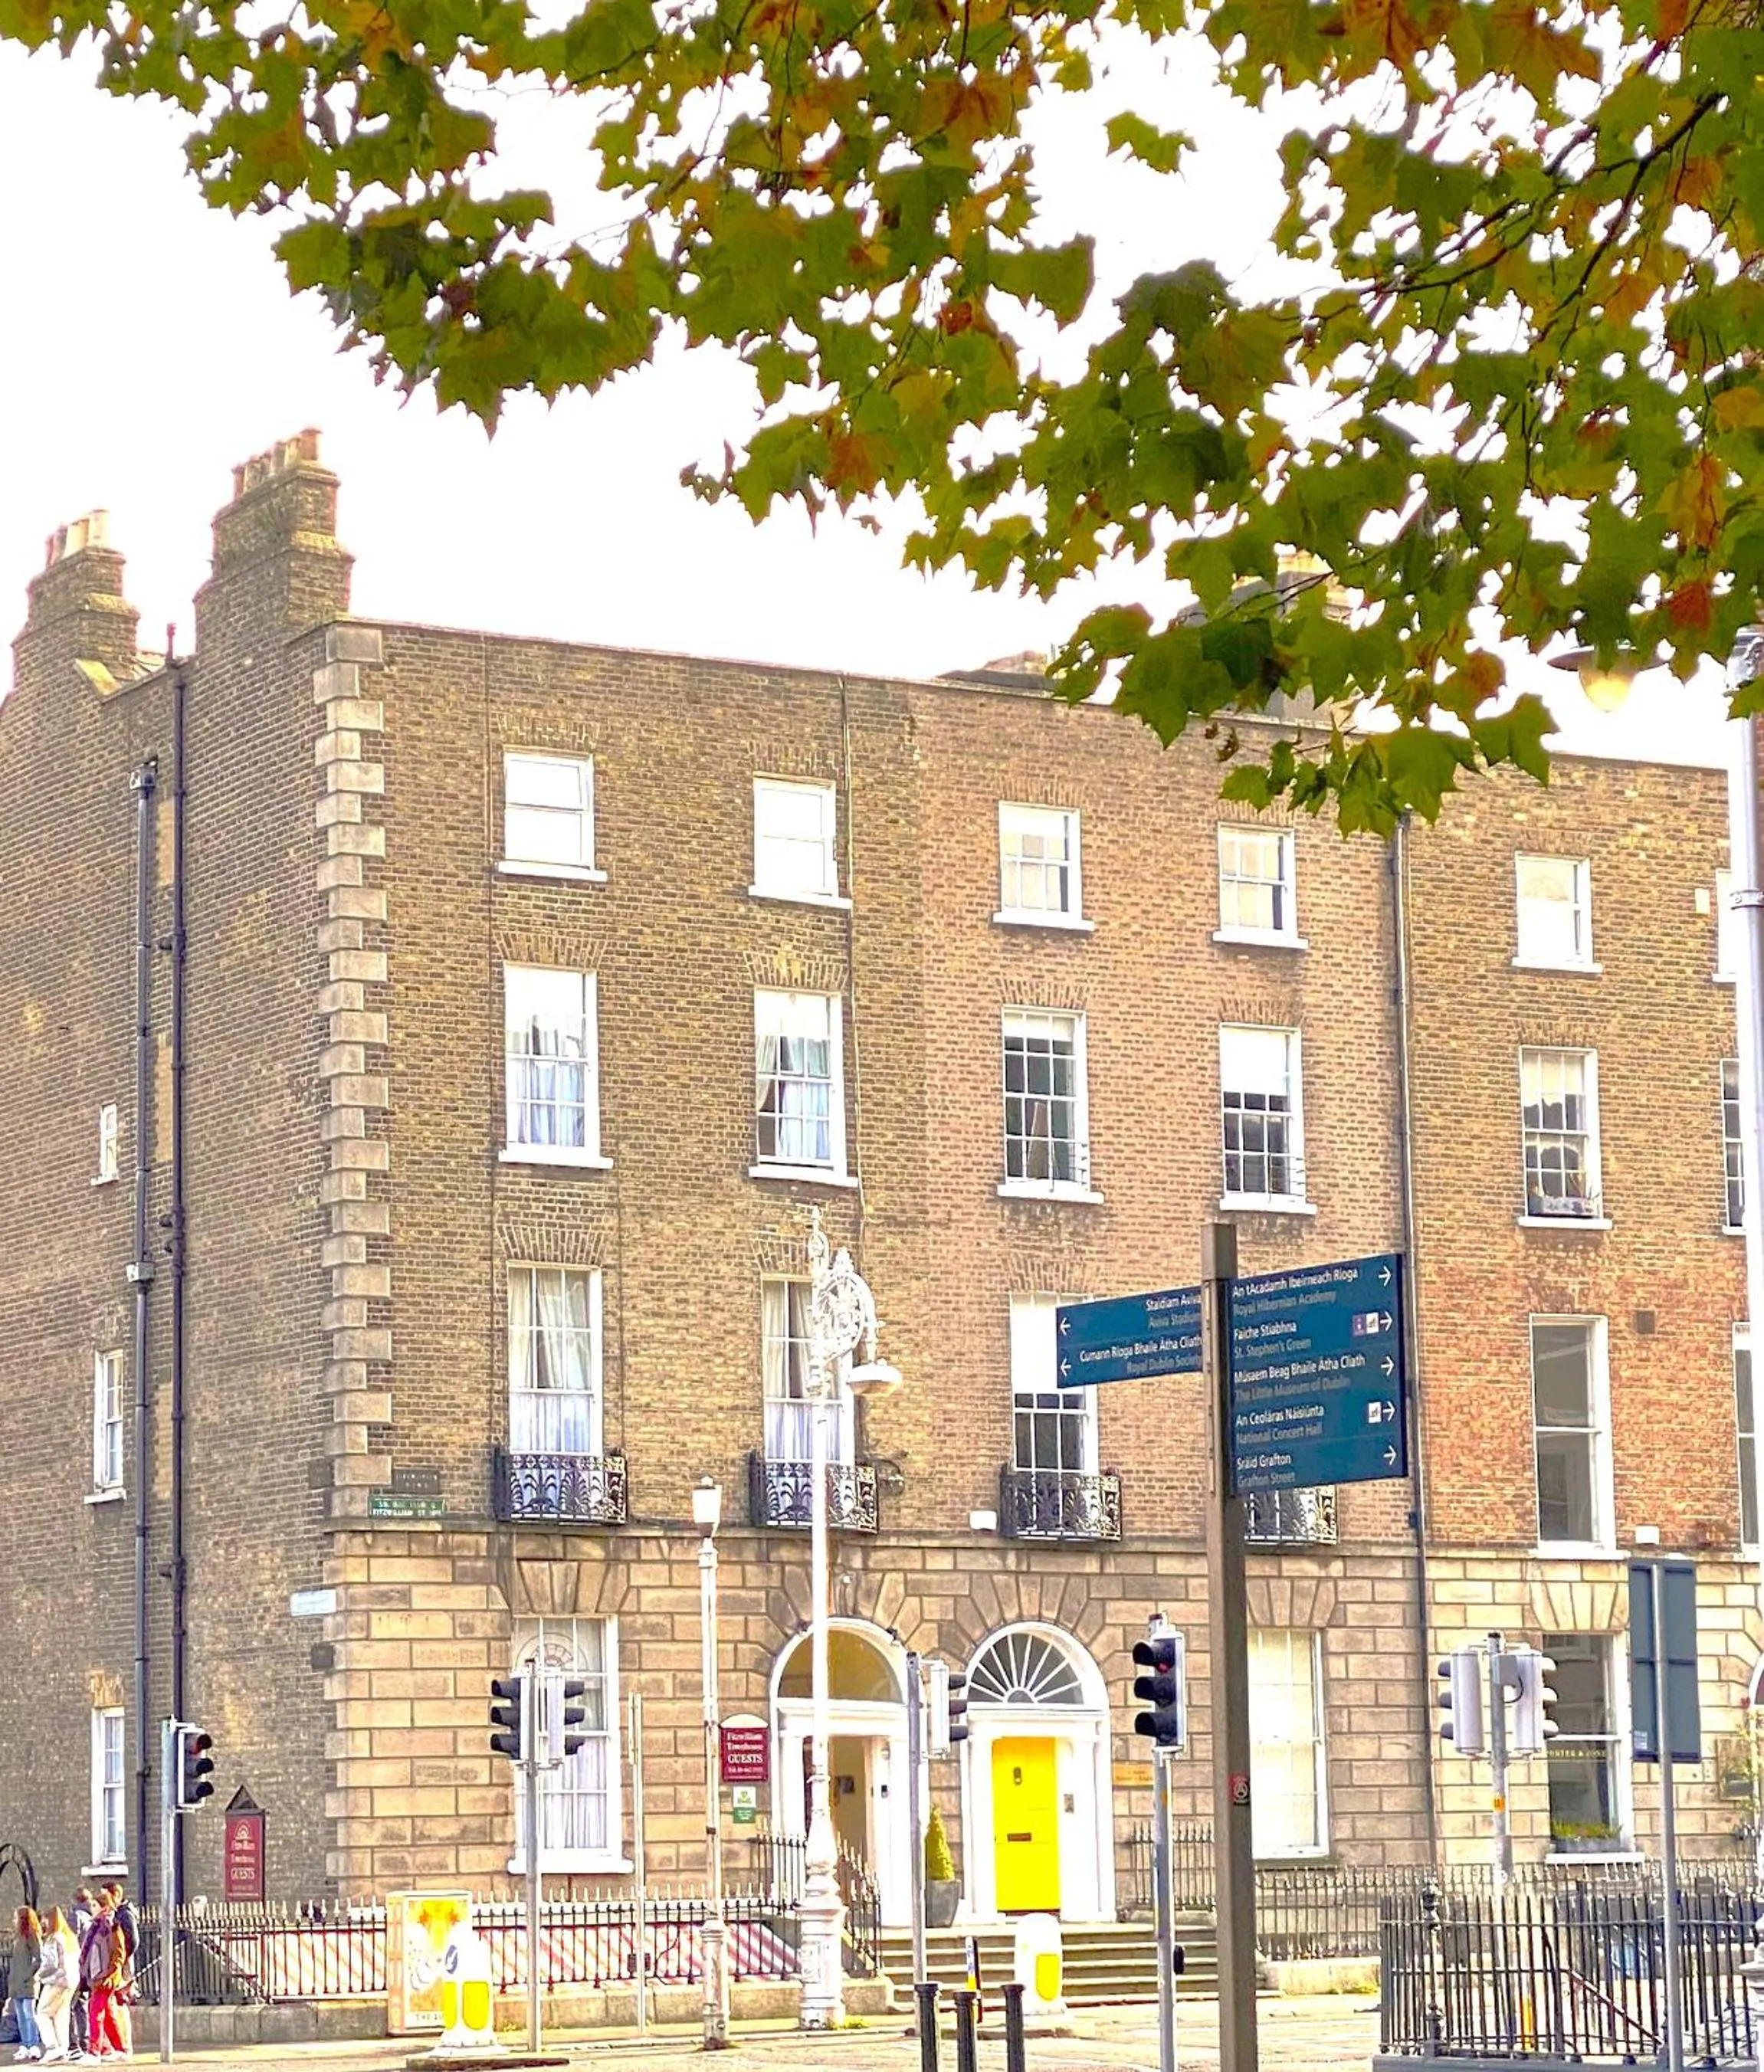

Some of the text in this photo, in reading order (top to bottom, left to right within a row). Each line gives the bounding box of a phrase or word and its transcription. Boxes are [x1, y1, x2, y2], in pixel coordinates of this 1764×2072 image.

[1233, 1285, 1244, 1297] An
[1233, 1300, 1256, 1316] Royal
[1299, 1290, 1337, 1305] Academy
[1234, 1326, 1259, 1340] Faiche
[1080, 1349, 1110, 1362] Cumann
[1134, 1341, 1158, 1355] Bhaile
[1286, 1338, 1312, 1351] Green
[1127, 1360, 1147, 1375] Royal
[1149, 1356, 1175, 1370] Dublin
[1269, 1365, 1290, 1379] Beag
[1291, 1361, 1317, 1375] Bhaile
[1340, 1353, 1366, 1369] Cliath
[1322, 1375, 1351, 1390] Dublin
[1235, 1415, 1248, 1426] An
[1236, 1421, 1323, 1444] National Concert Hall
[1259, 1453, 1291, 1467] Grafton
[1238, 1471, 1295, 1487] Grafton Street
[727, 1753, 763, 1764] GUESTS
[231, 1867, 255, 1880] GUESTS
